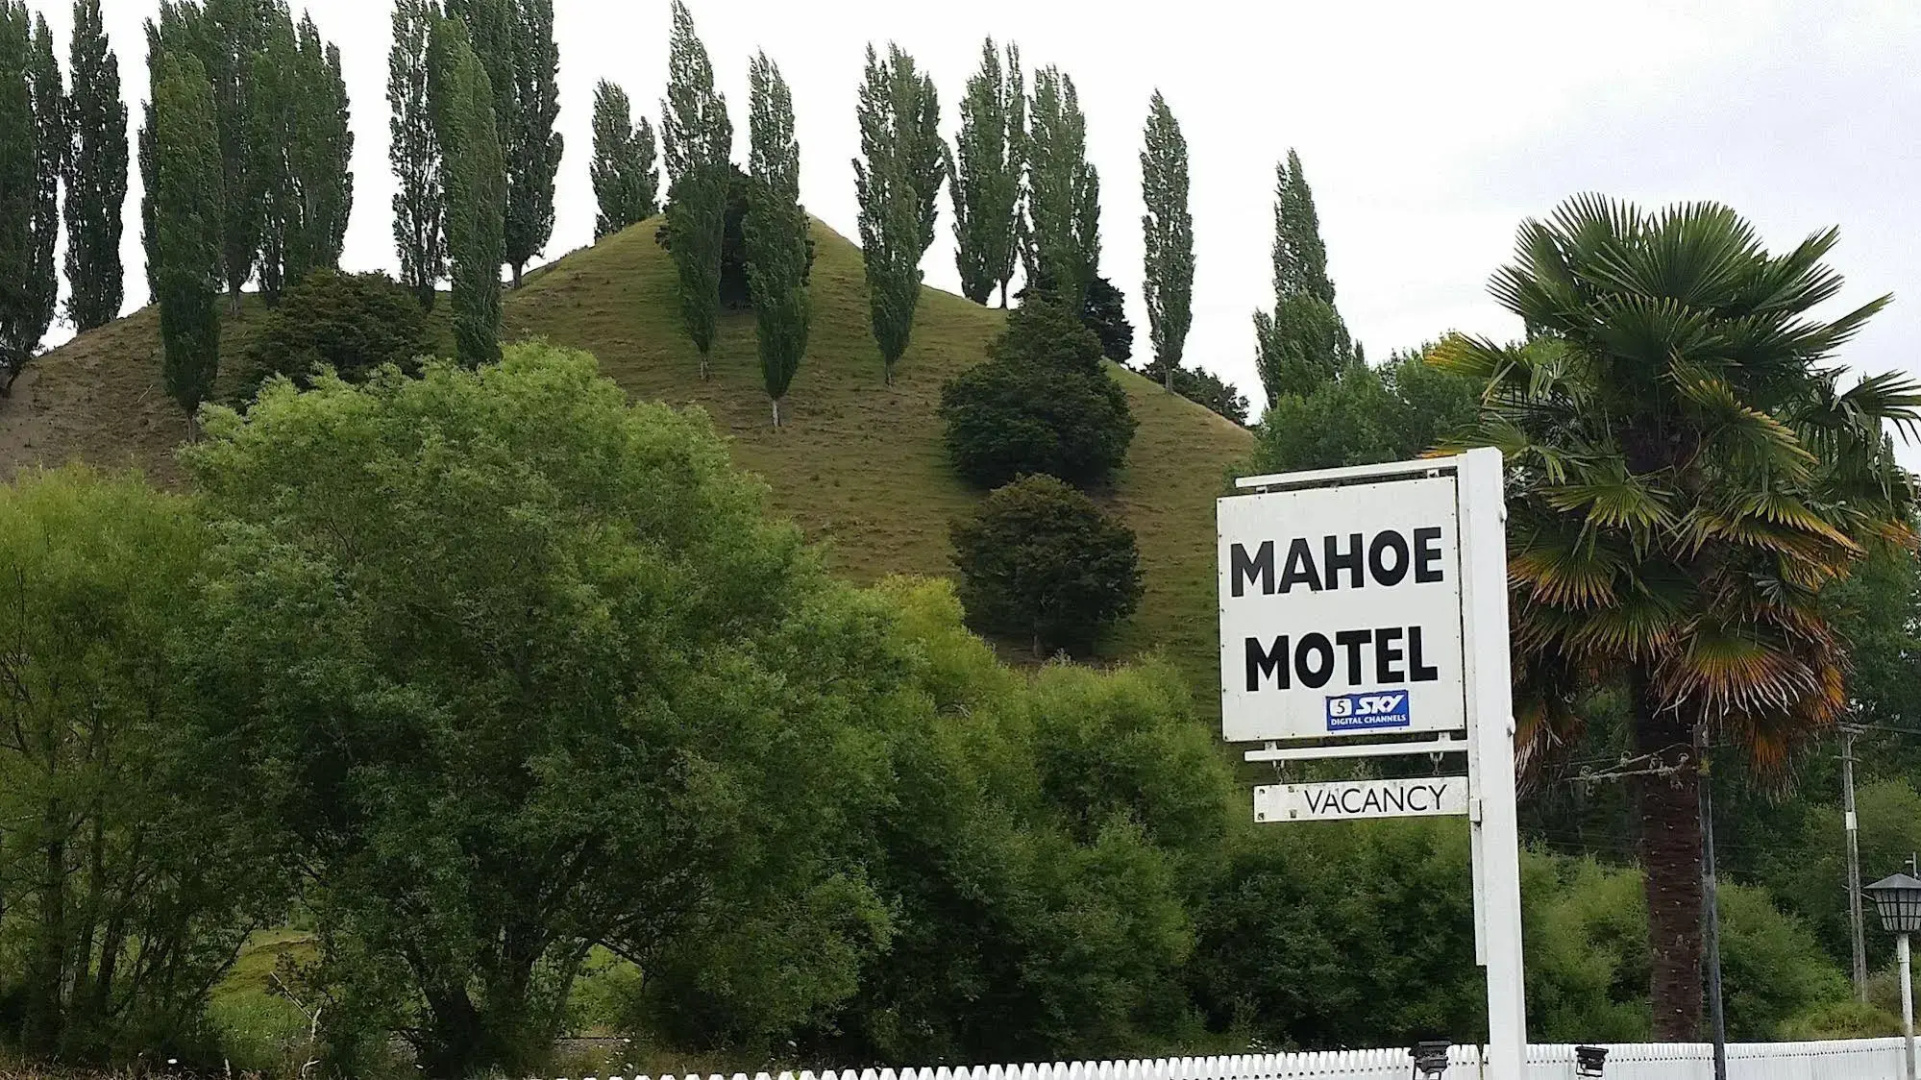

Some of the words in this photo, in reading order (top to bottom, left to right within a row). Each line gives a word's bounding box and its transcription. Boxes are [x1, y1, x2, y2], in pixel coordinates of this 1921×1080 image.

[1231, 527, 1443, 597] MAHOE
[1245, 626, 1438, 692] MOTEL
[1336, 700, 1345, 714] 5
[1355, 694, 1404, 715] SKY
[1331, 717, 1362, 726] DIGITAL
[1364, 714, 1406, 724] CHANNELS
[1304, 784, 1447, 814] VACANCY
